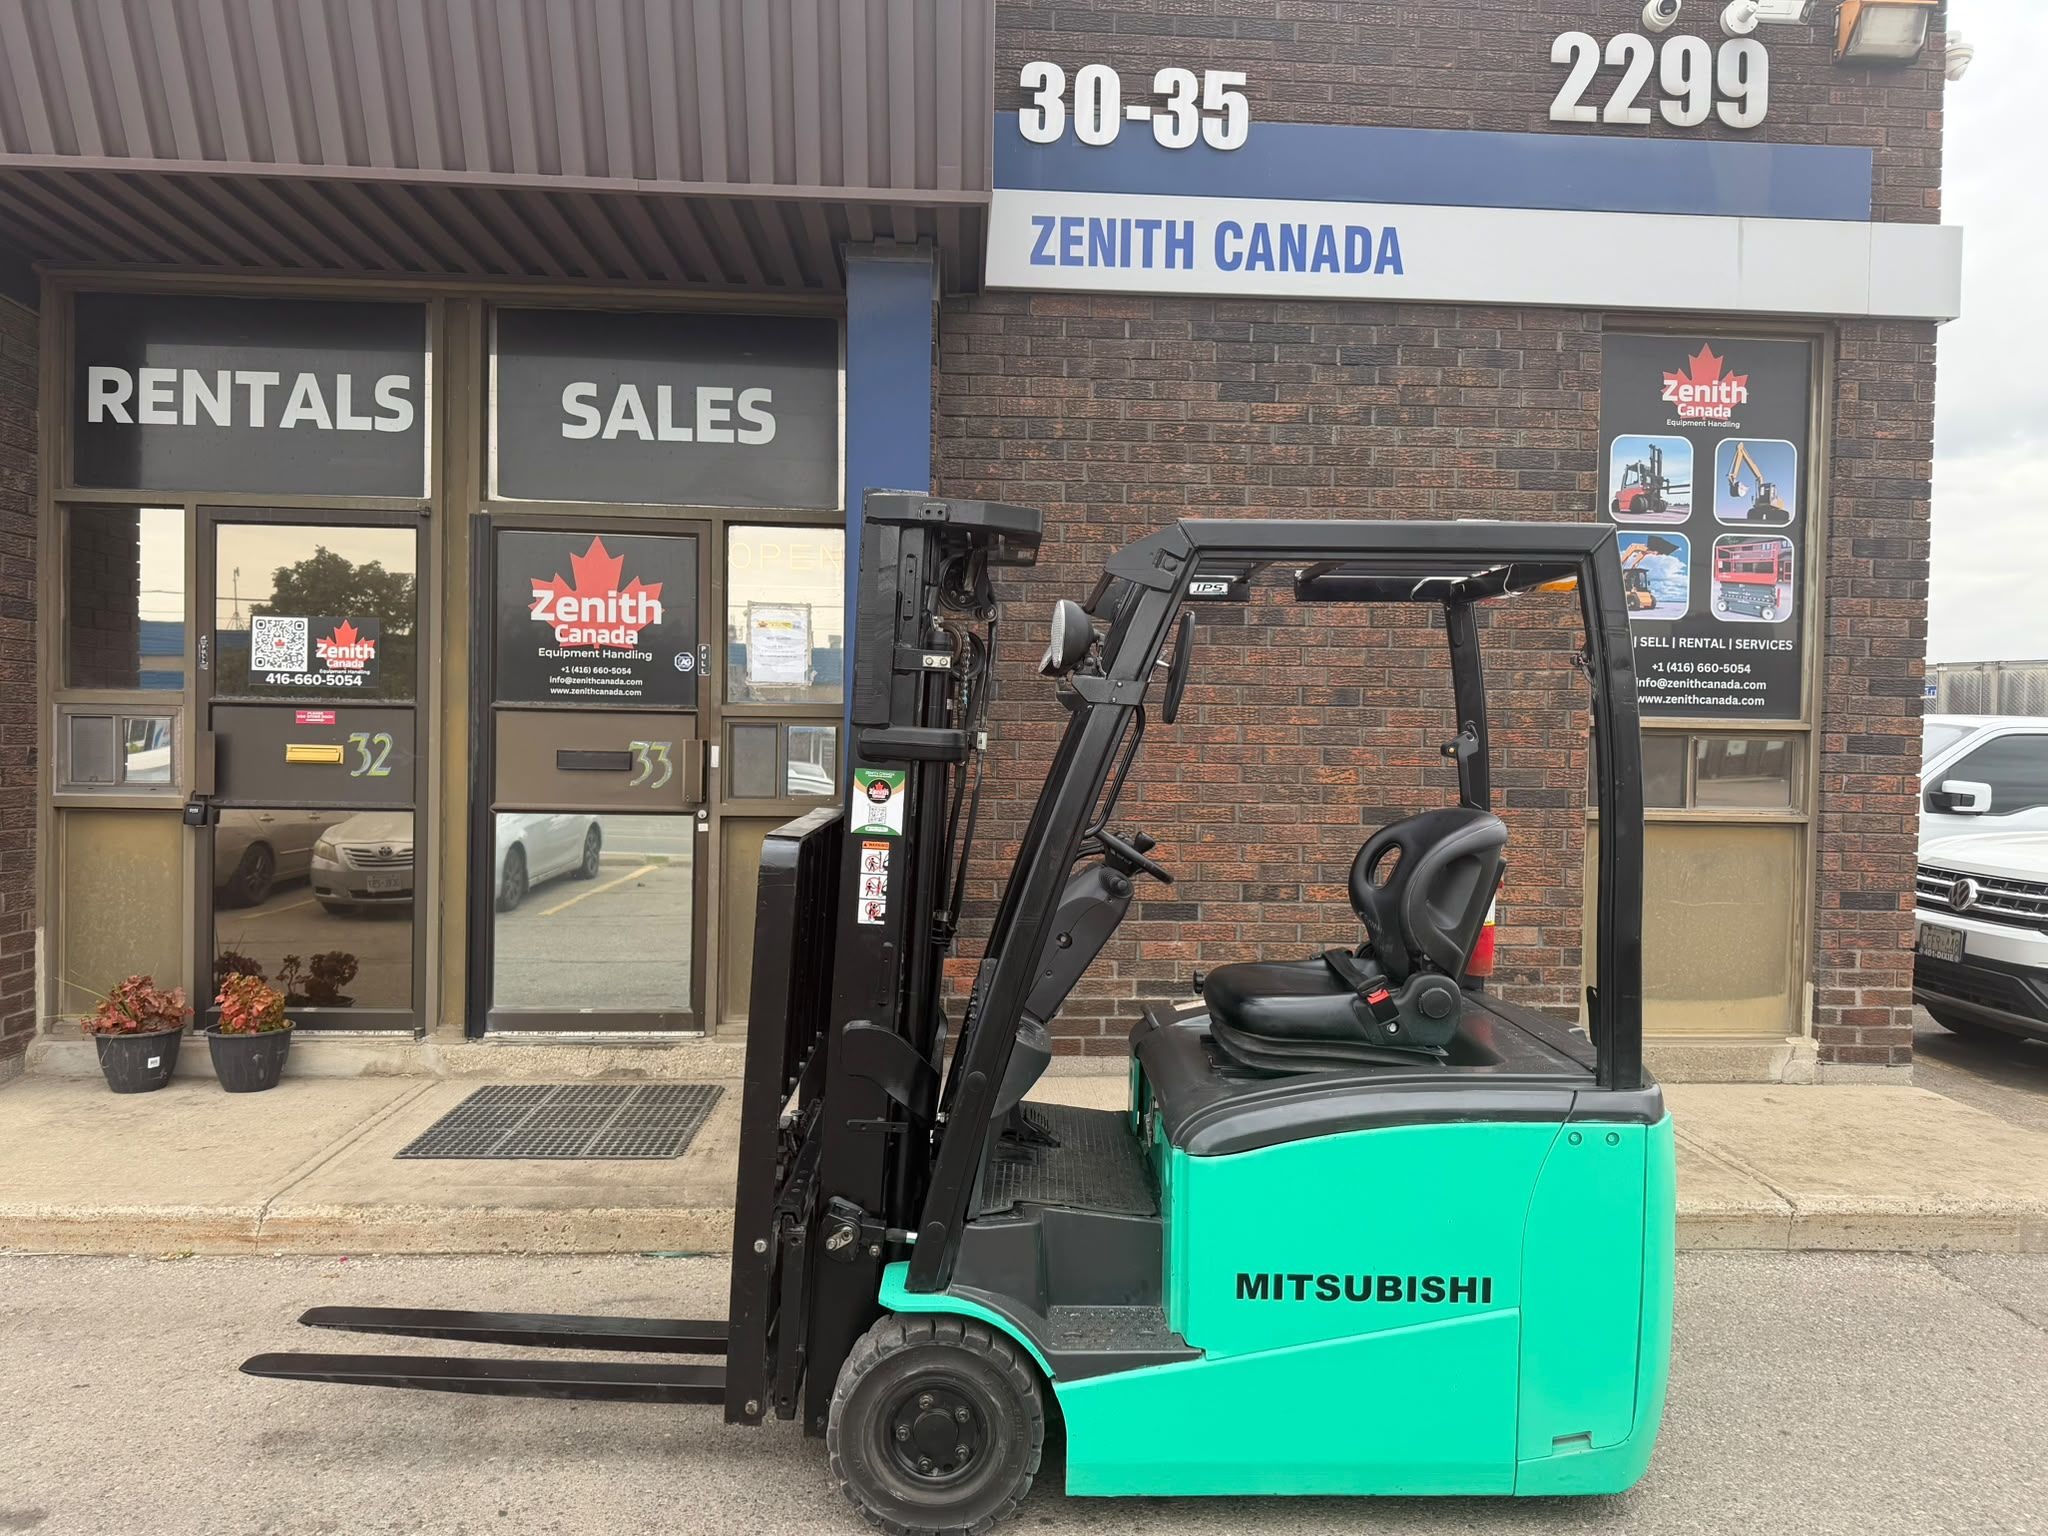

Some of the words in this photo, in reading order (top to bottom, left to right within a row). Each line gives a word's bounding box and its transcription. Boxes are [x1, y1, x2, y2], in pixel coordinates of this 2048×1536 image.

[1550, 31, 1769, 129] 2299
[1019, 62, 1249, 150] 30-35
[1031, 215, 1195, 271] ZENITH
[1215, 219, 1405, 277] CANADA
[87, 366, 415, 434] RENTALS
[1662, 379, 1748, 403] Zenith
[561, 381, 777, 446] SALES
[1677, 403, 1732, 418] Canada
[1666, 419, 1706, 428] Equipment
[1707, 420, 1741, 429] Handling
[530, 589, 662, 625] Zenith
[554, 624, 639, 645] Canada
[1639, 637, 1669, 648] SELL
[1679, 637, 1726, 649] RENTAL
[1735, 639, 1793, 650] SERVICES
[316, 642, 375, 659] Zenith
[538, 647, 600, 659] Equipment
[602, 649, 653, 661] Handling
[326, 659, 365, 668] Canada
[571, 666, 591, 674] (416)
[593, 666, 632, 675] 660-5054
[1652, 662, 1665, 672] +1
[1666, 661, 1694, 673] (416)
[1696, 662, 1752, 674] 660-5054
[265, 672, 363, 687] 416-660-5054
[549, 675, 643, 686] info@zenithcanada.com
[550, 687, 642, 696] www.zenithcanada.com
[347, 732, 394, 777] 32
[628, 740, 673, 789] 33
[1236, 1272, 1492, 1304] MITSUBISHI
